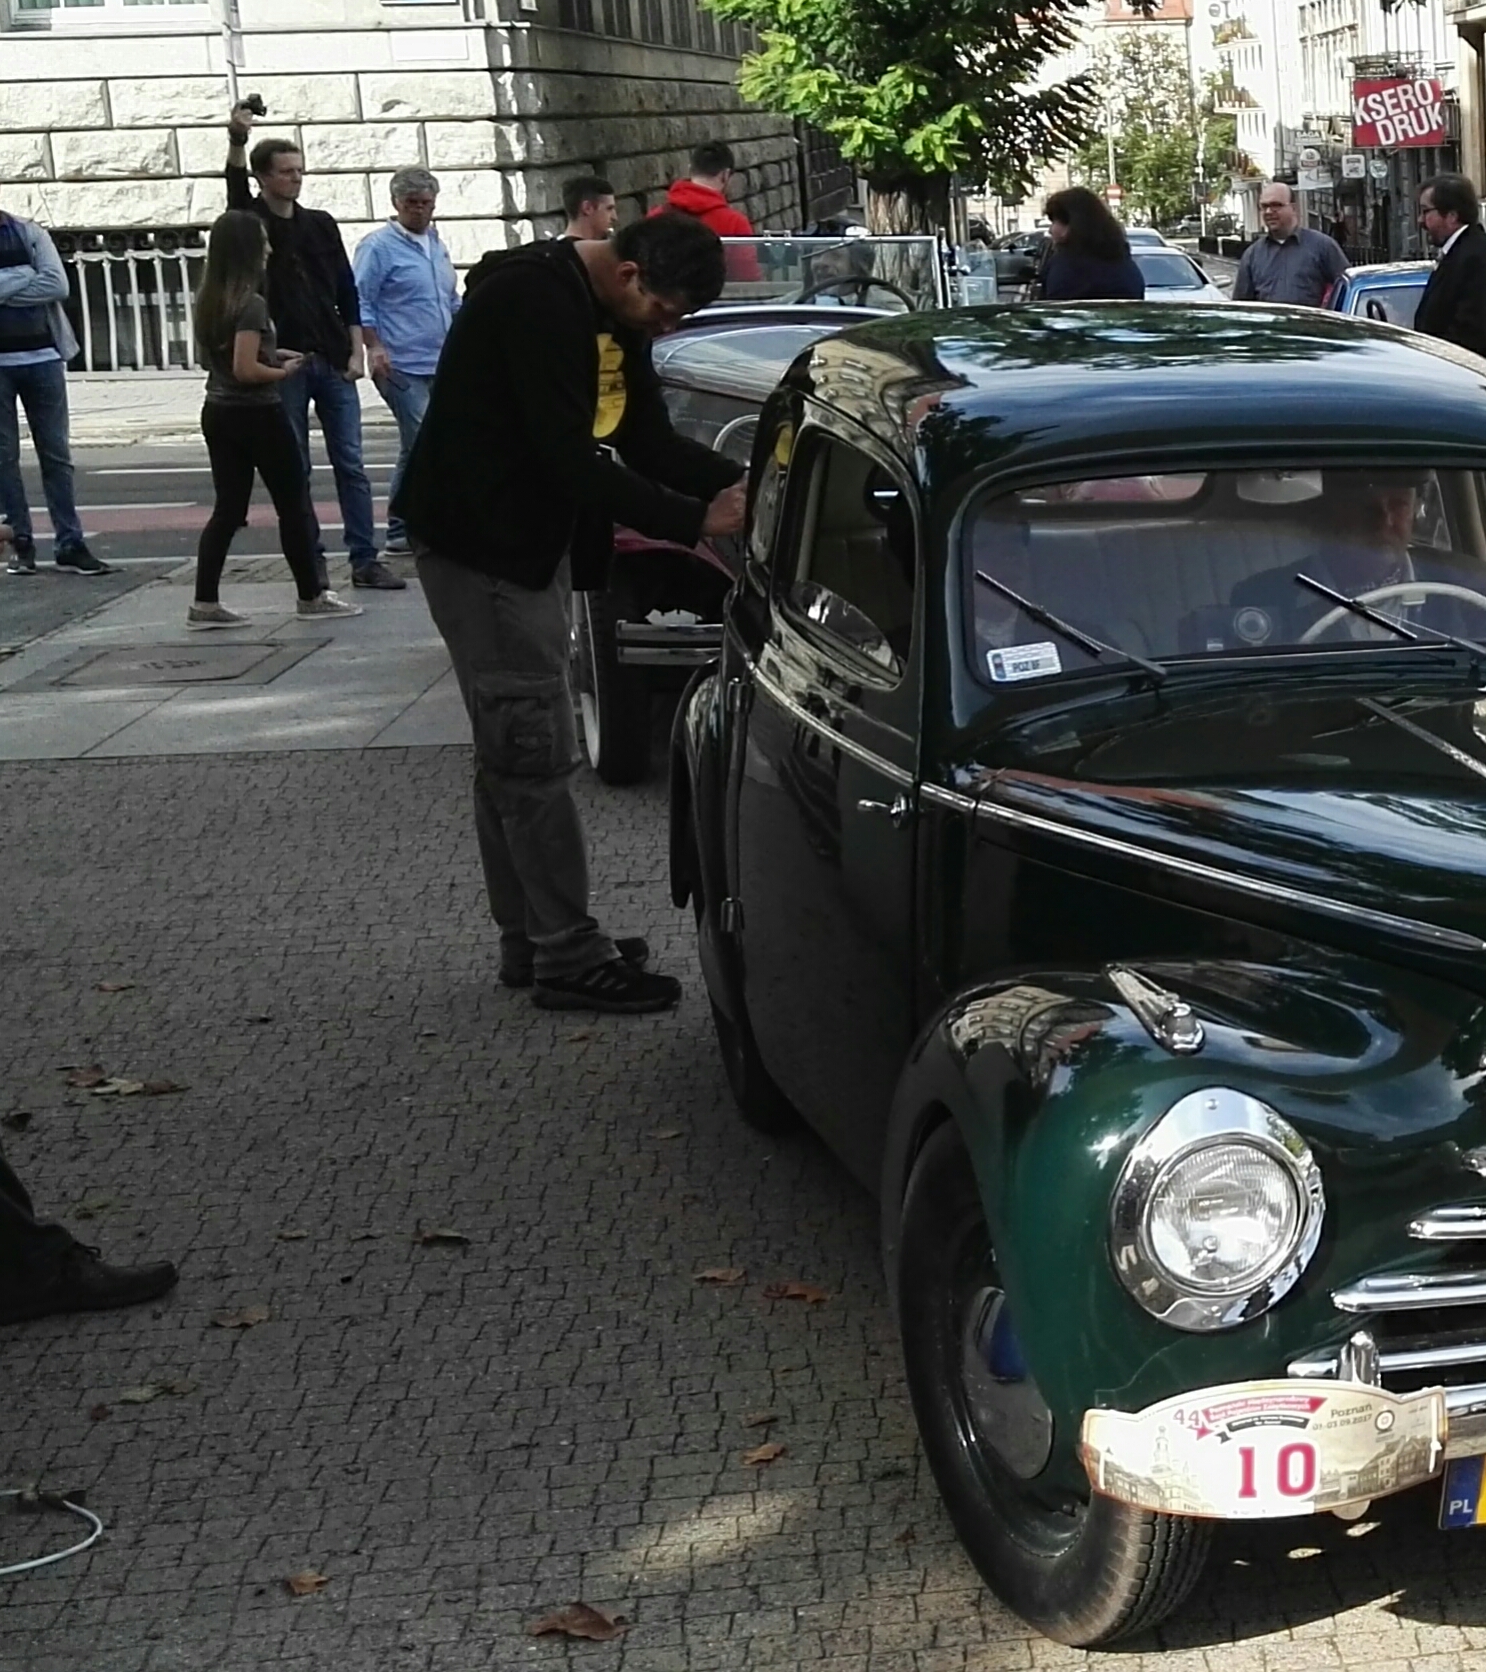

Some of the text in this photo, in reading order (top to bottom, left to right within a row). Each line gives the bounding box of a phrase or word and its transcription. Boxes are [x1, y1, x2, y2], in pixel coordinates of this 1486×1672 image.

[1353, 80, 1434, 126] KSERO
[1375, 101, 1443, 146] DRUK
[1331, 1402, 1373, 1419] Poznań
[1238, 1442, 1316, 1499] 10
[1449, 1498, 1473, 1515] PL
